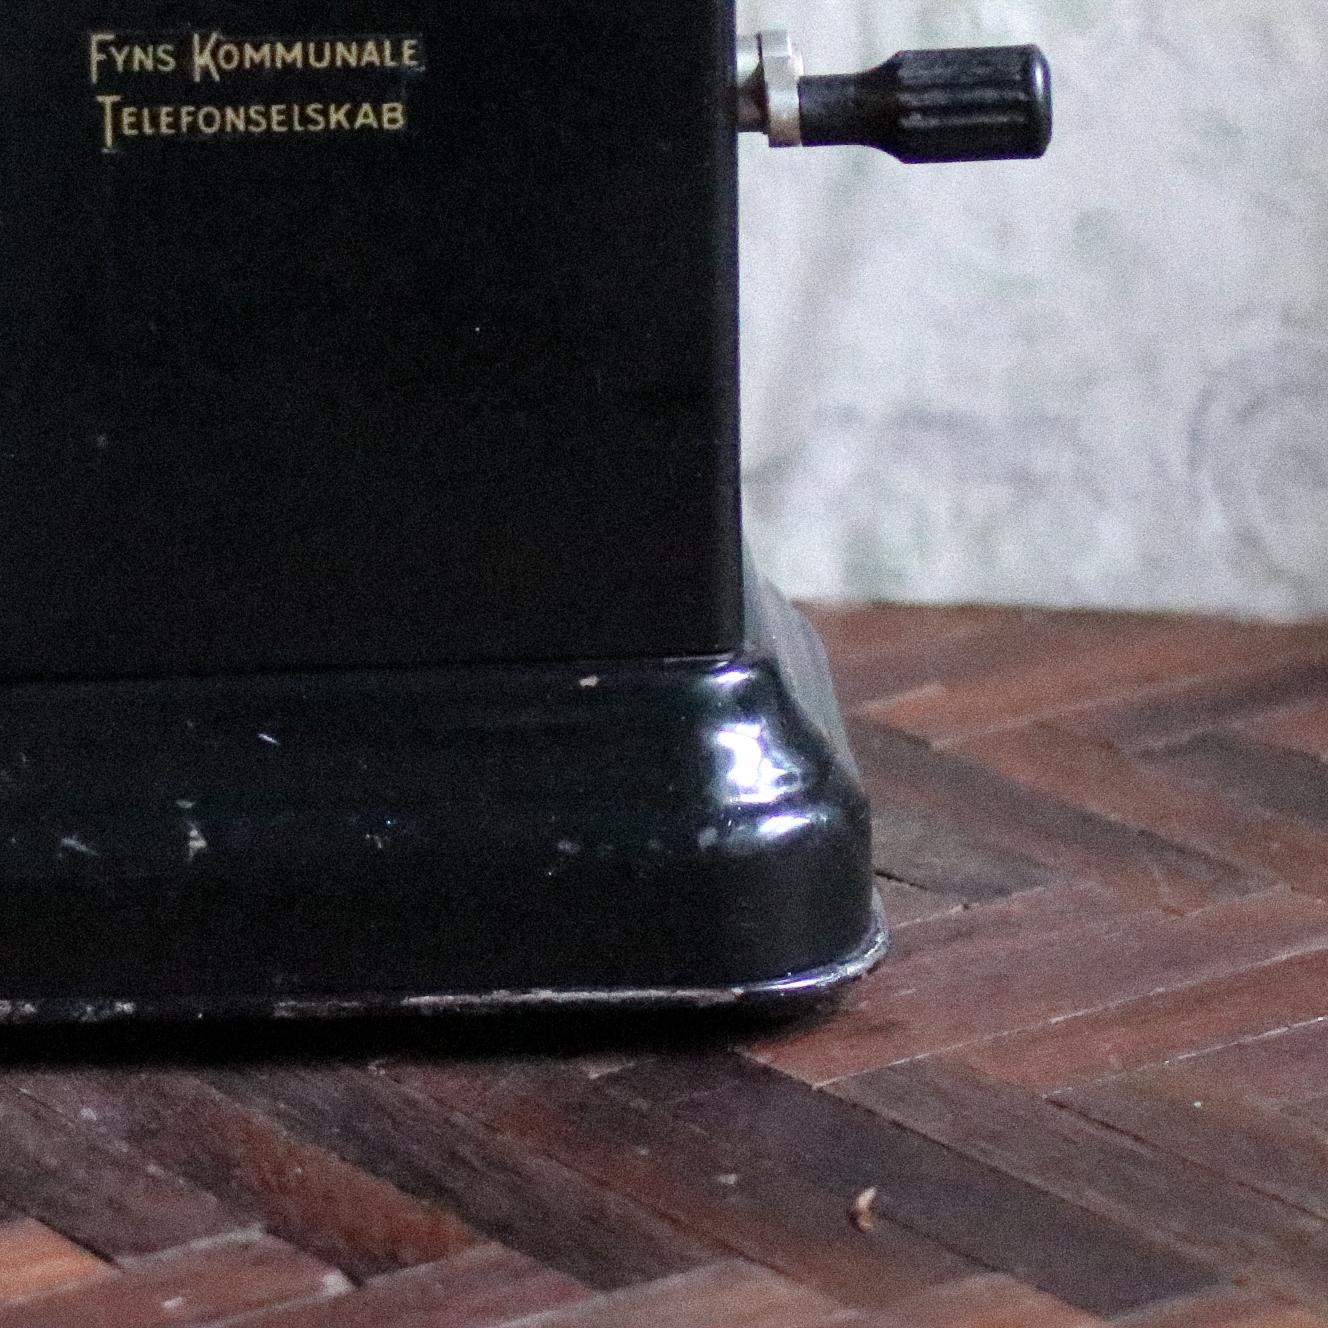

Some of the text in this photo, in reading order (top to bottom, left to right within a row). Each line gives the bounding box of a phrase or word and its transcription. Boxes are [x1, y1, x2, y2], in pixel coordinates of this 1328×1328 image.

[89, 31, 419, 84] FYNS KOMMUNALE
[95, 94, 406, 149] TELEFONSELSKAB
